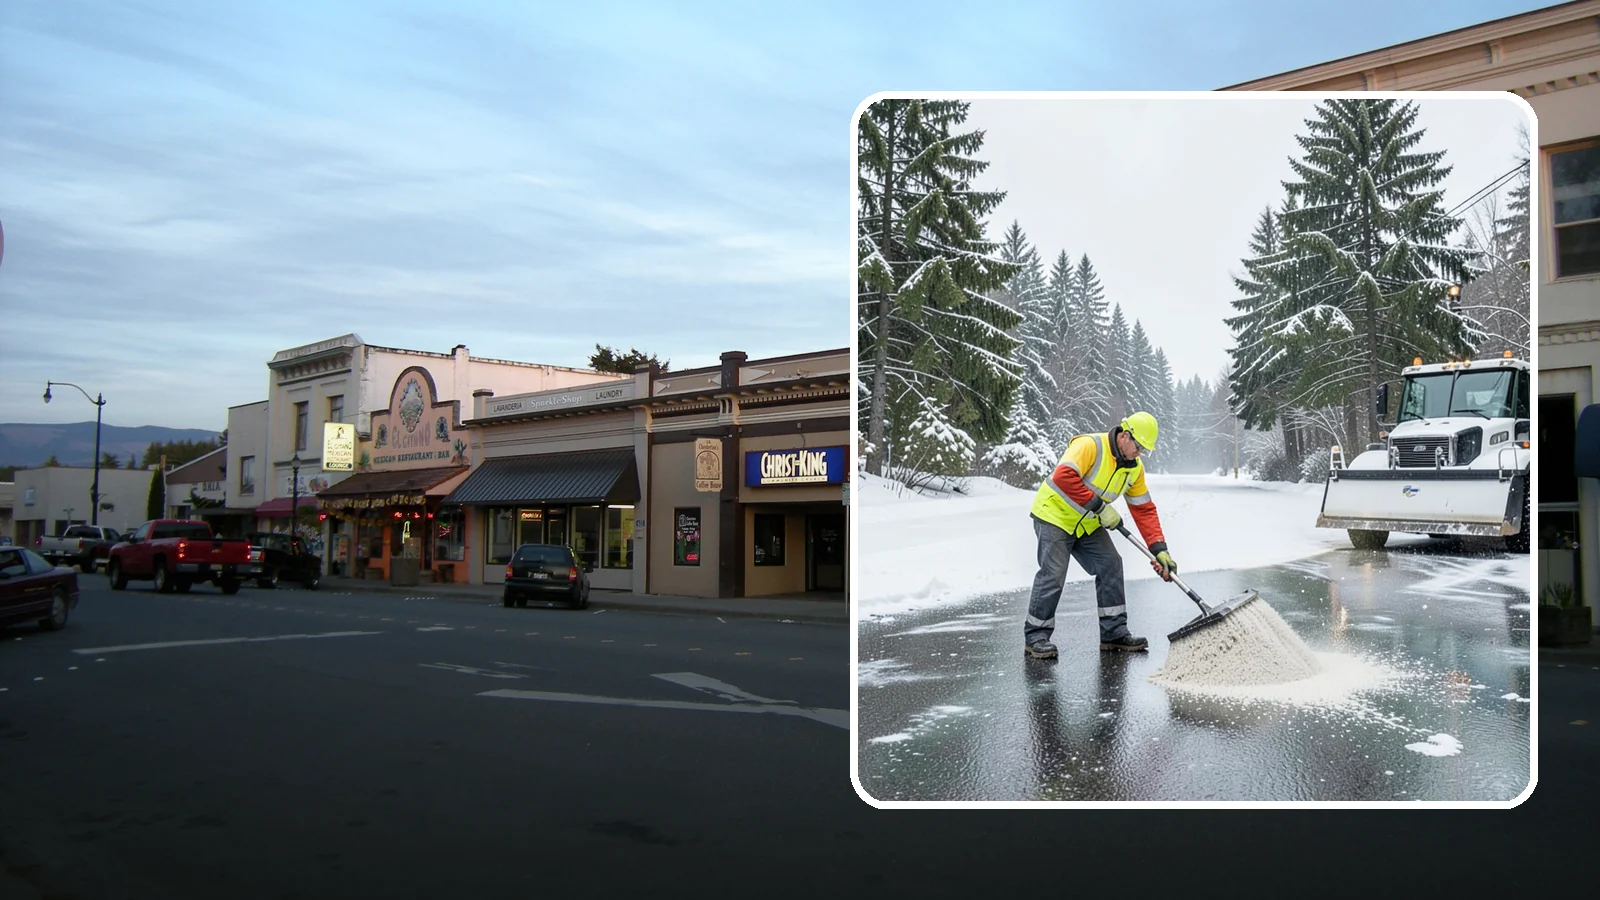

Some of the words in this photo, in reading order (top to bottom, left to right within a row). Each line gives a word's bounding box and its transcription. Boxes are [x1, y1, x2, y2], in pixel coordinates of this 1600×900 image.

[493, 403, 523, 413] LAVANDERIA
[530, 397, 561, 409] Sparkle
[561, 394, 583, 405] Shop
[595, 389, 623, 400] LAUNDRY
[373, 455, 396, 464] MEXICAN
[397, 451, 434, 462] RESTAURANT
[437, 450, 450, 459] BAR
[761, 452, 797, 478] CHRIST
[799, 450, 827, 476] KING
